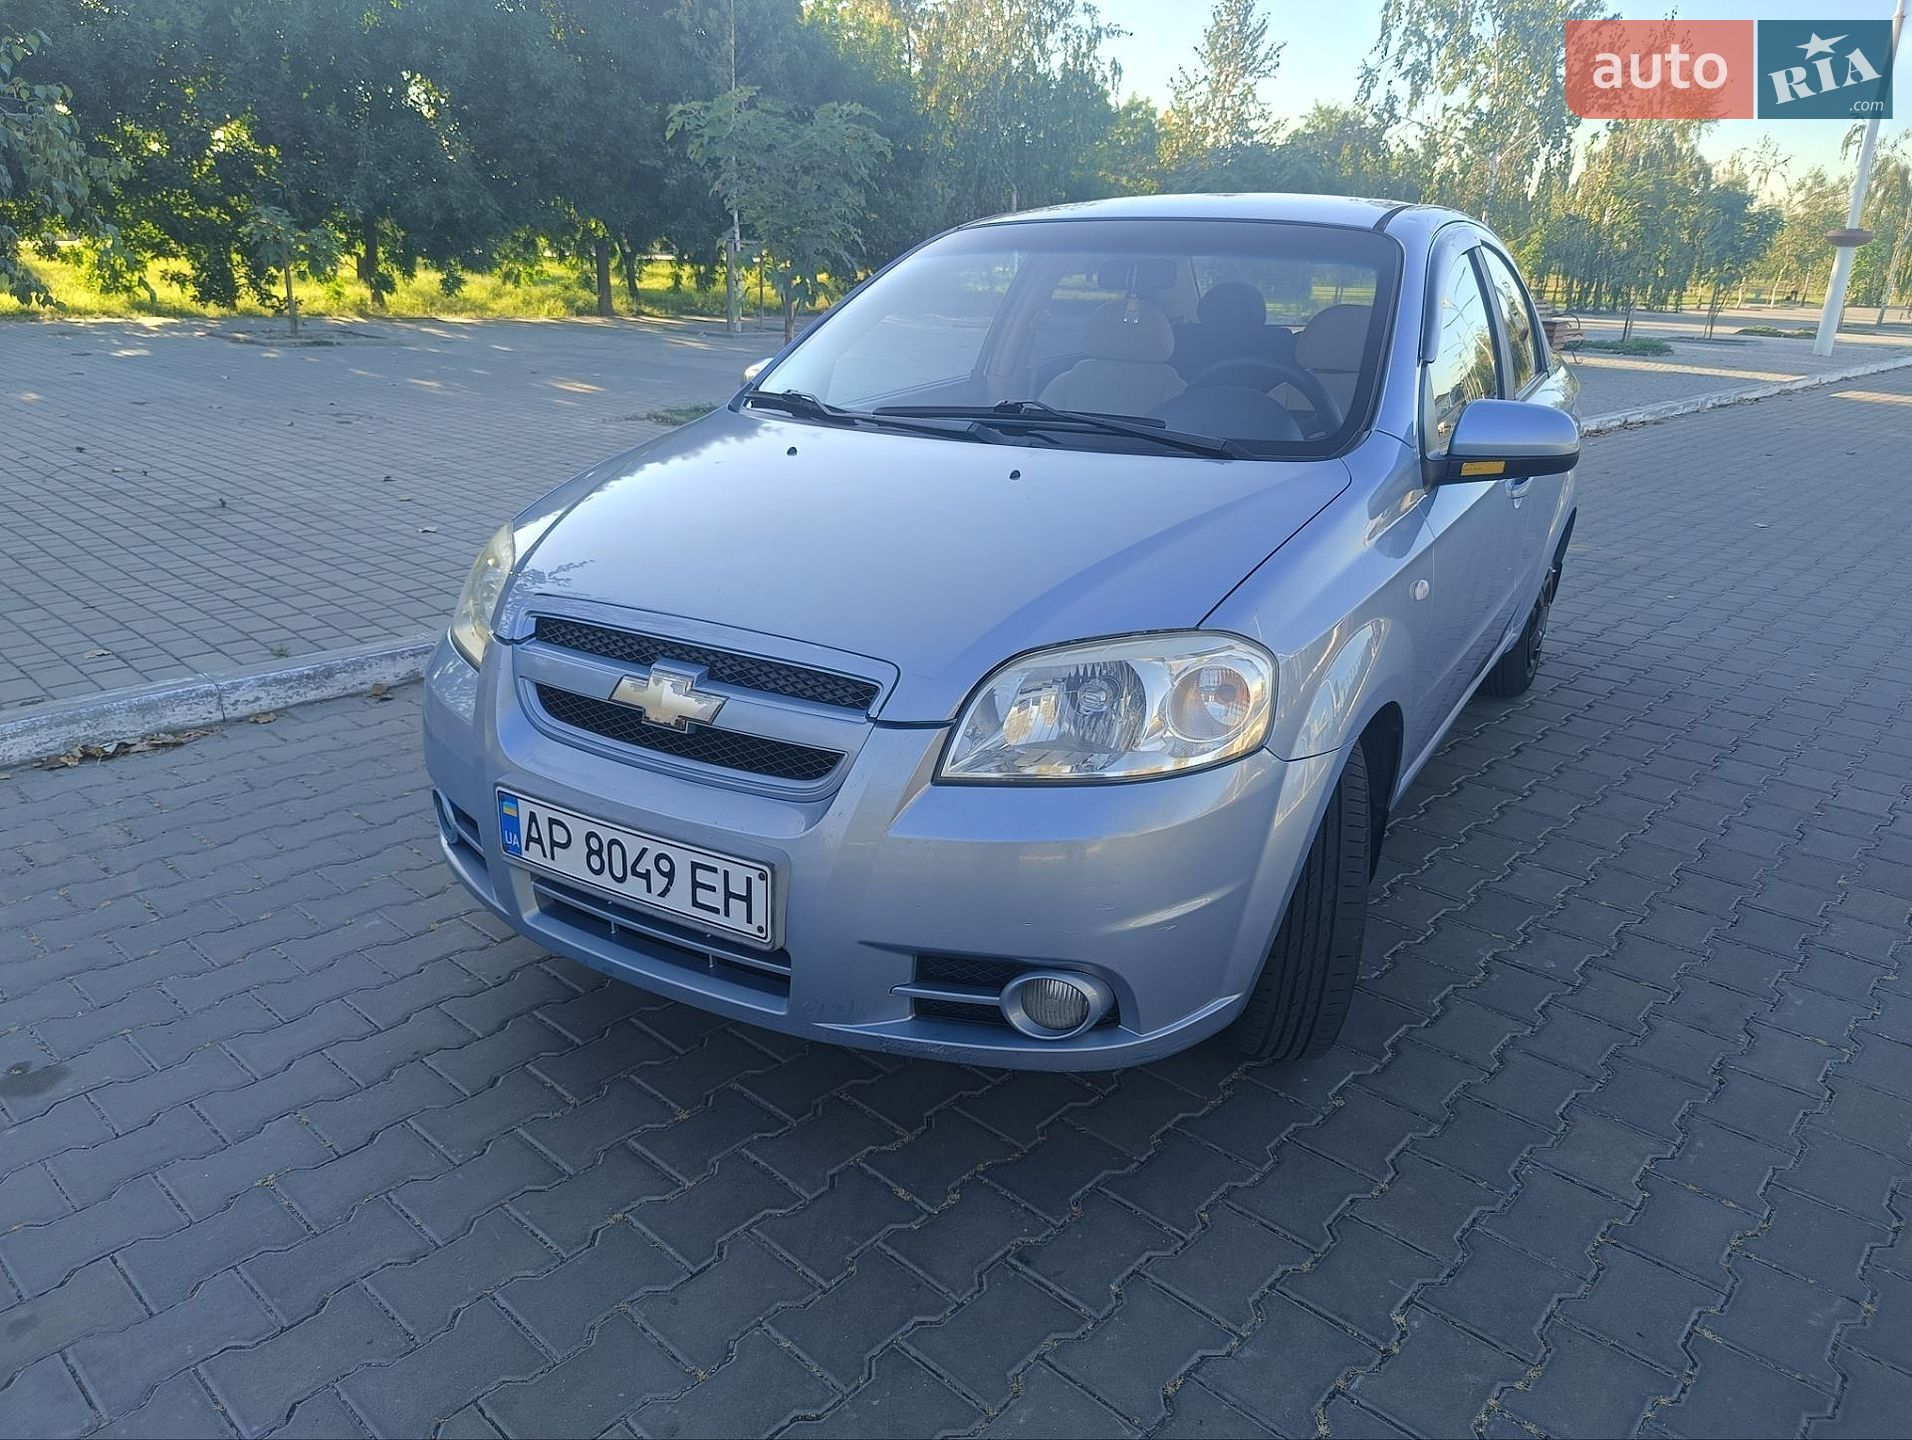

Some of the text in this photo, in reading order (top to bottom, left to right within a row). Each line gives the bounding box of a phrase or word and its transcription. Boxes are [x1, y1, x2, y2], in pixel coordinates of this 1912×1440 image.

[505, 830, 520, 847] UA
[525, 811, 753, 925] AP 8049 EH
